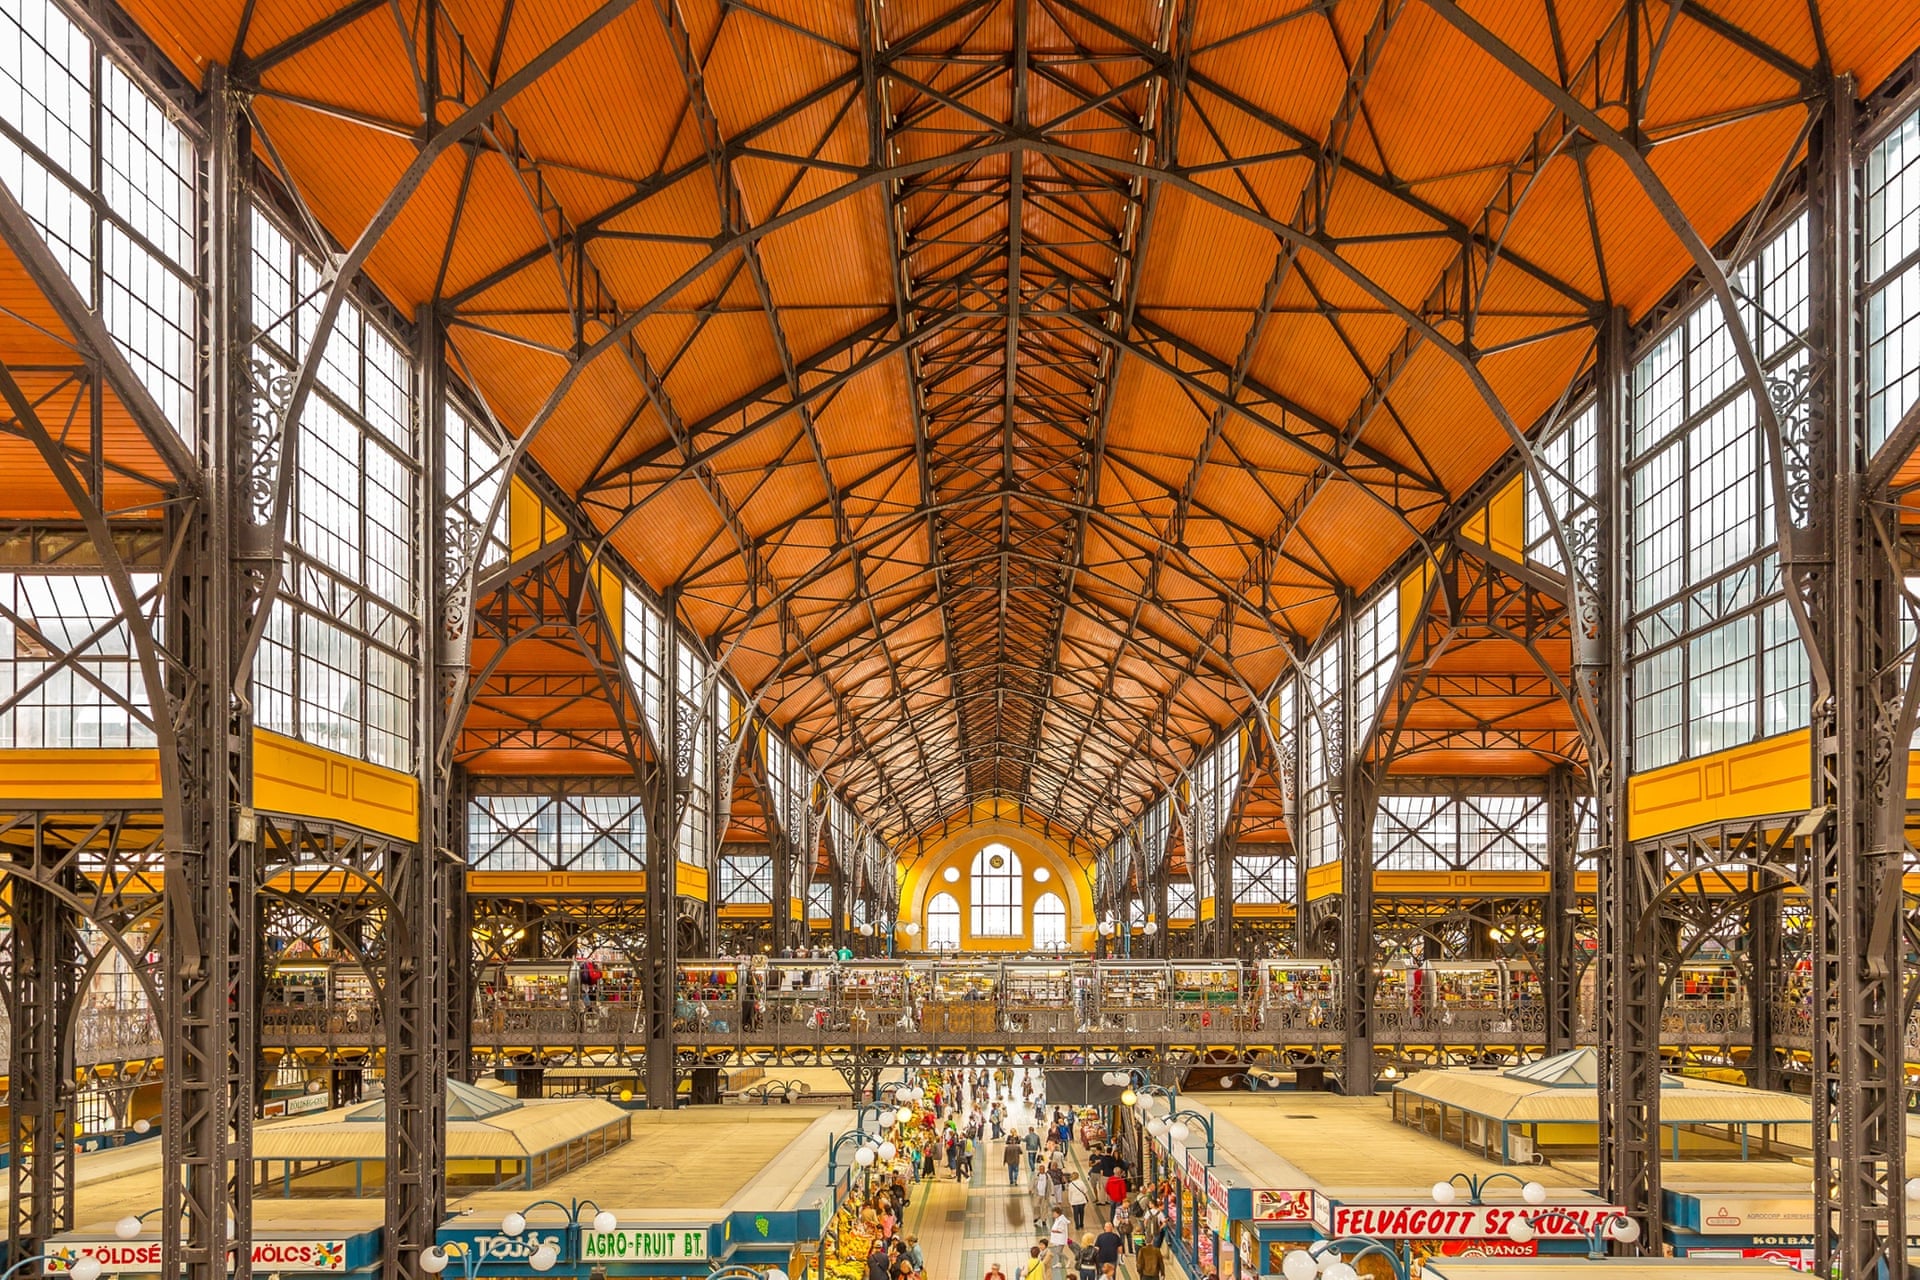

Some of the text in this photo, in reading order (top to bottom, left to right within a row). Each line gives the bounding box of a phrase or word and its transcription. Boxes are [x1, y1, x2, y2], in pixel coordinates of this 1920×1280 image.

[1336, 1207, 1476, 1235] FELVÁGOTT
[586, 1232, 704, 1258] AGRO-FRUIT BT.
